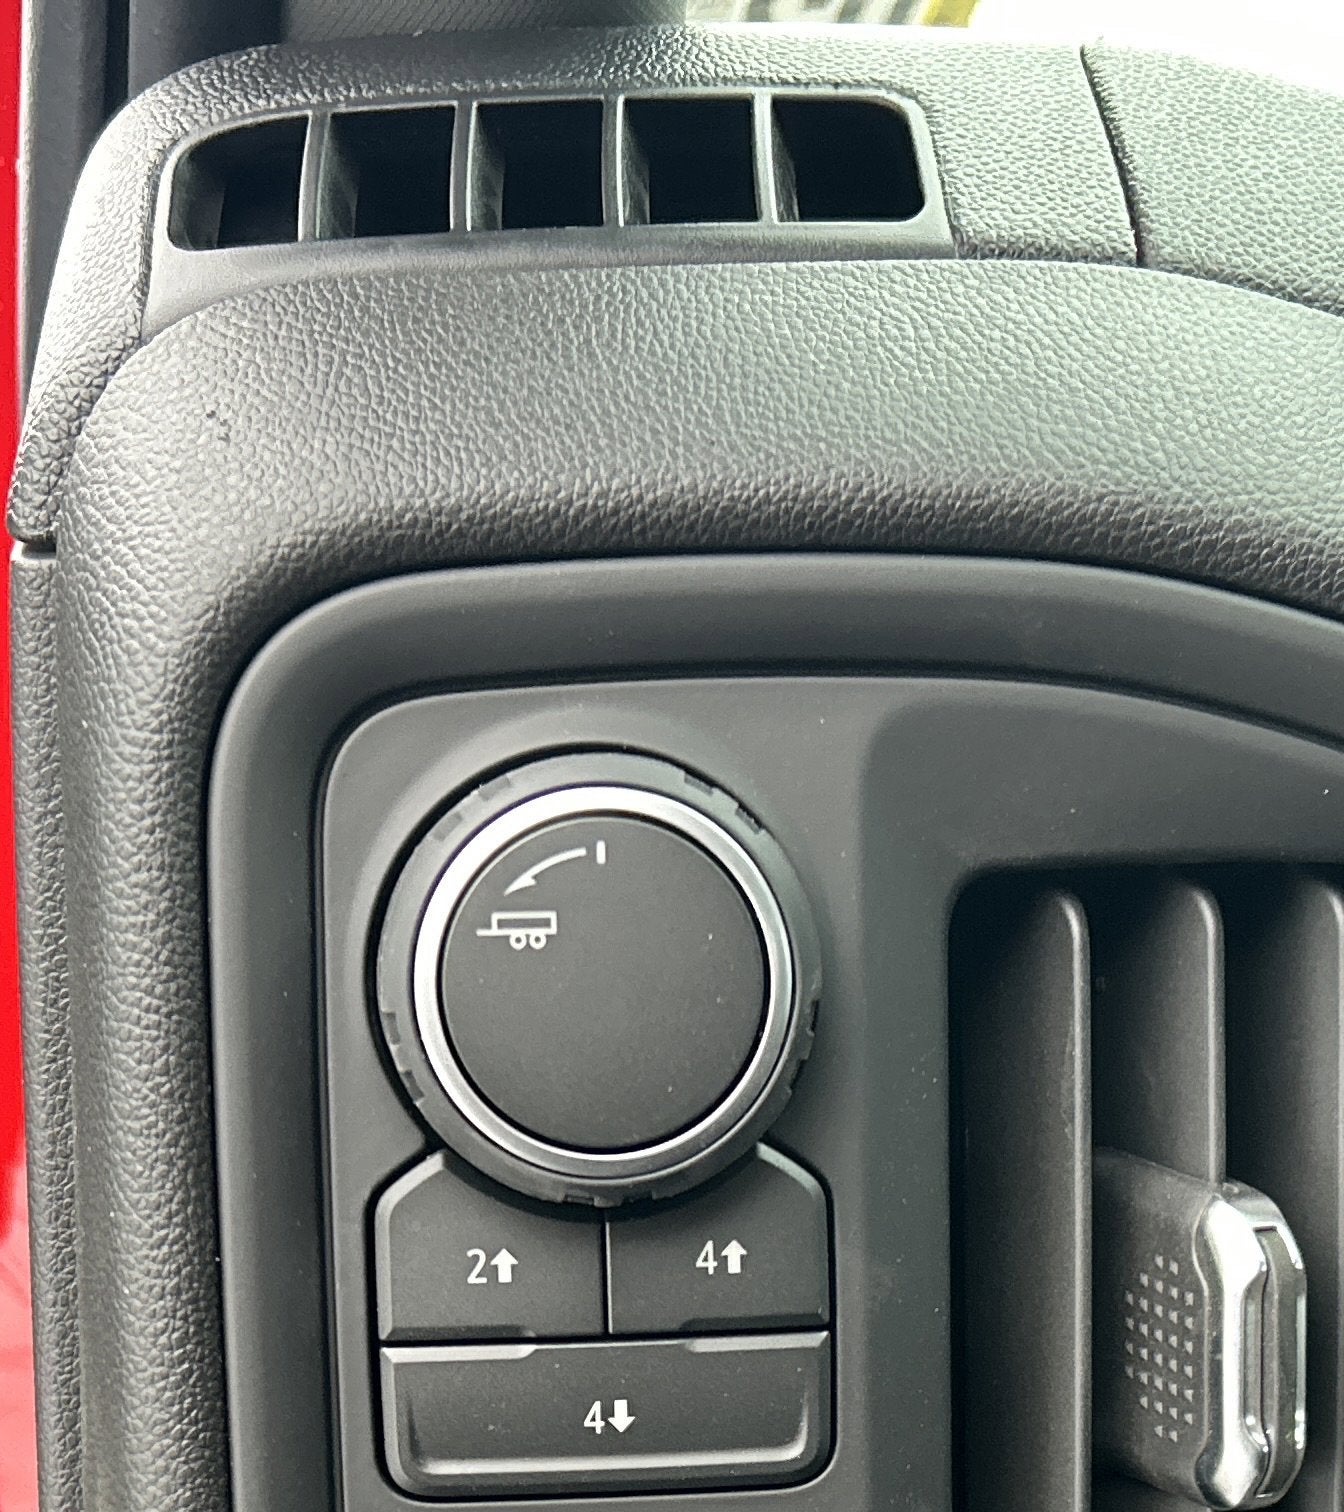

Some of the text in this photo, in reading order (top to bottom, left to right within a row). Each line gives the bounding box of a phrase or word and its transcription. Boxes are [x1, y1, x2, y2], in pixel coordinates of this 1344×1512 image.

[466, 1248, 488, 1285] 2
[695, 1240, 718, 1275] 4
[583, 1400, 606, 1435] 4
